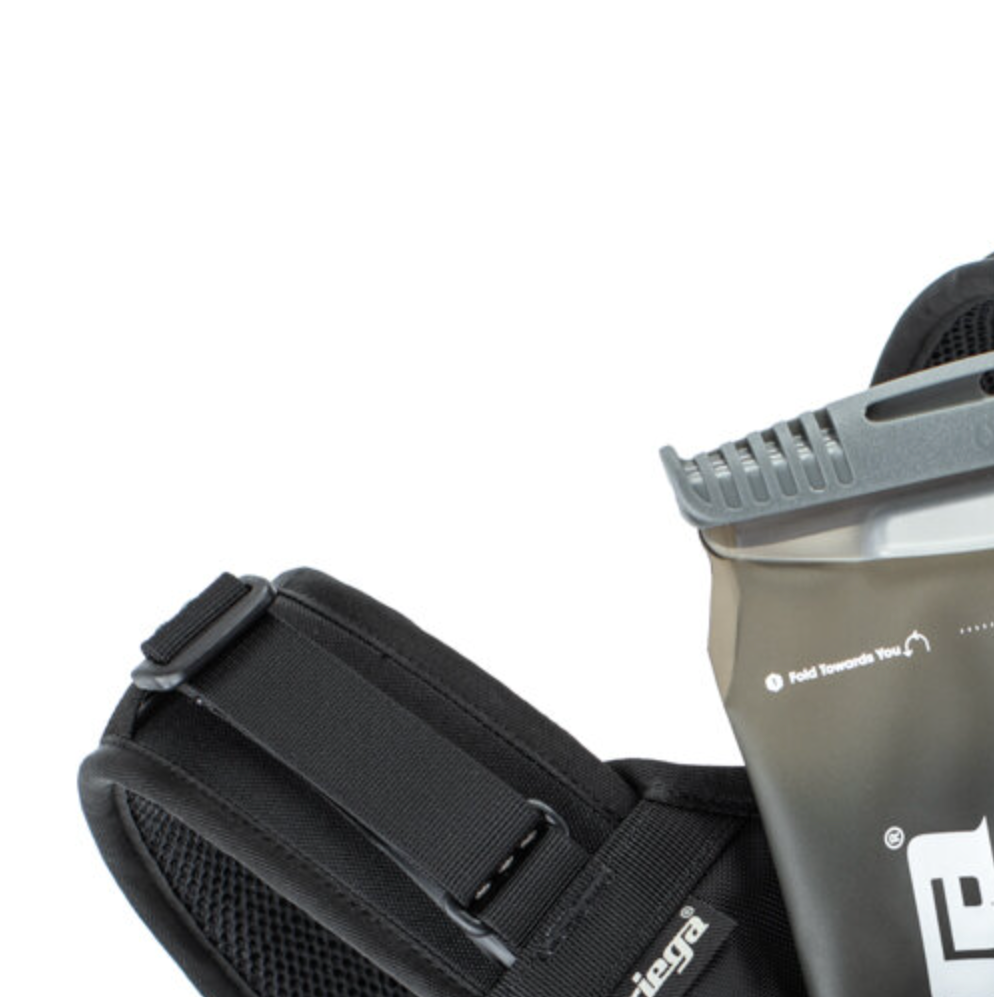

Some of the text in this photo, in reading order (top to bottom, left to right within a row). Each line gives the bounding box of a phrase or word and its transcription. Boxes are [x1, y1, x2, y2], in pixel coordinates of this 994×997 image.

[788, 666, 818, 684] Fold
[818, 652, 875, 676] Towards
[875, 646, 901, 660] You
